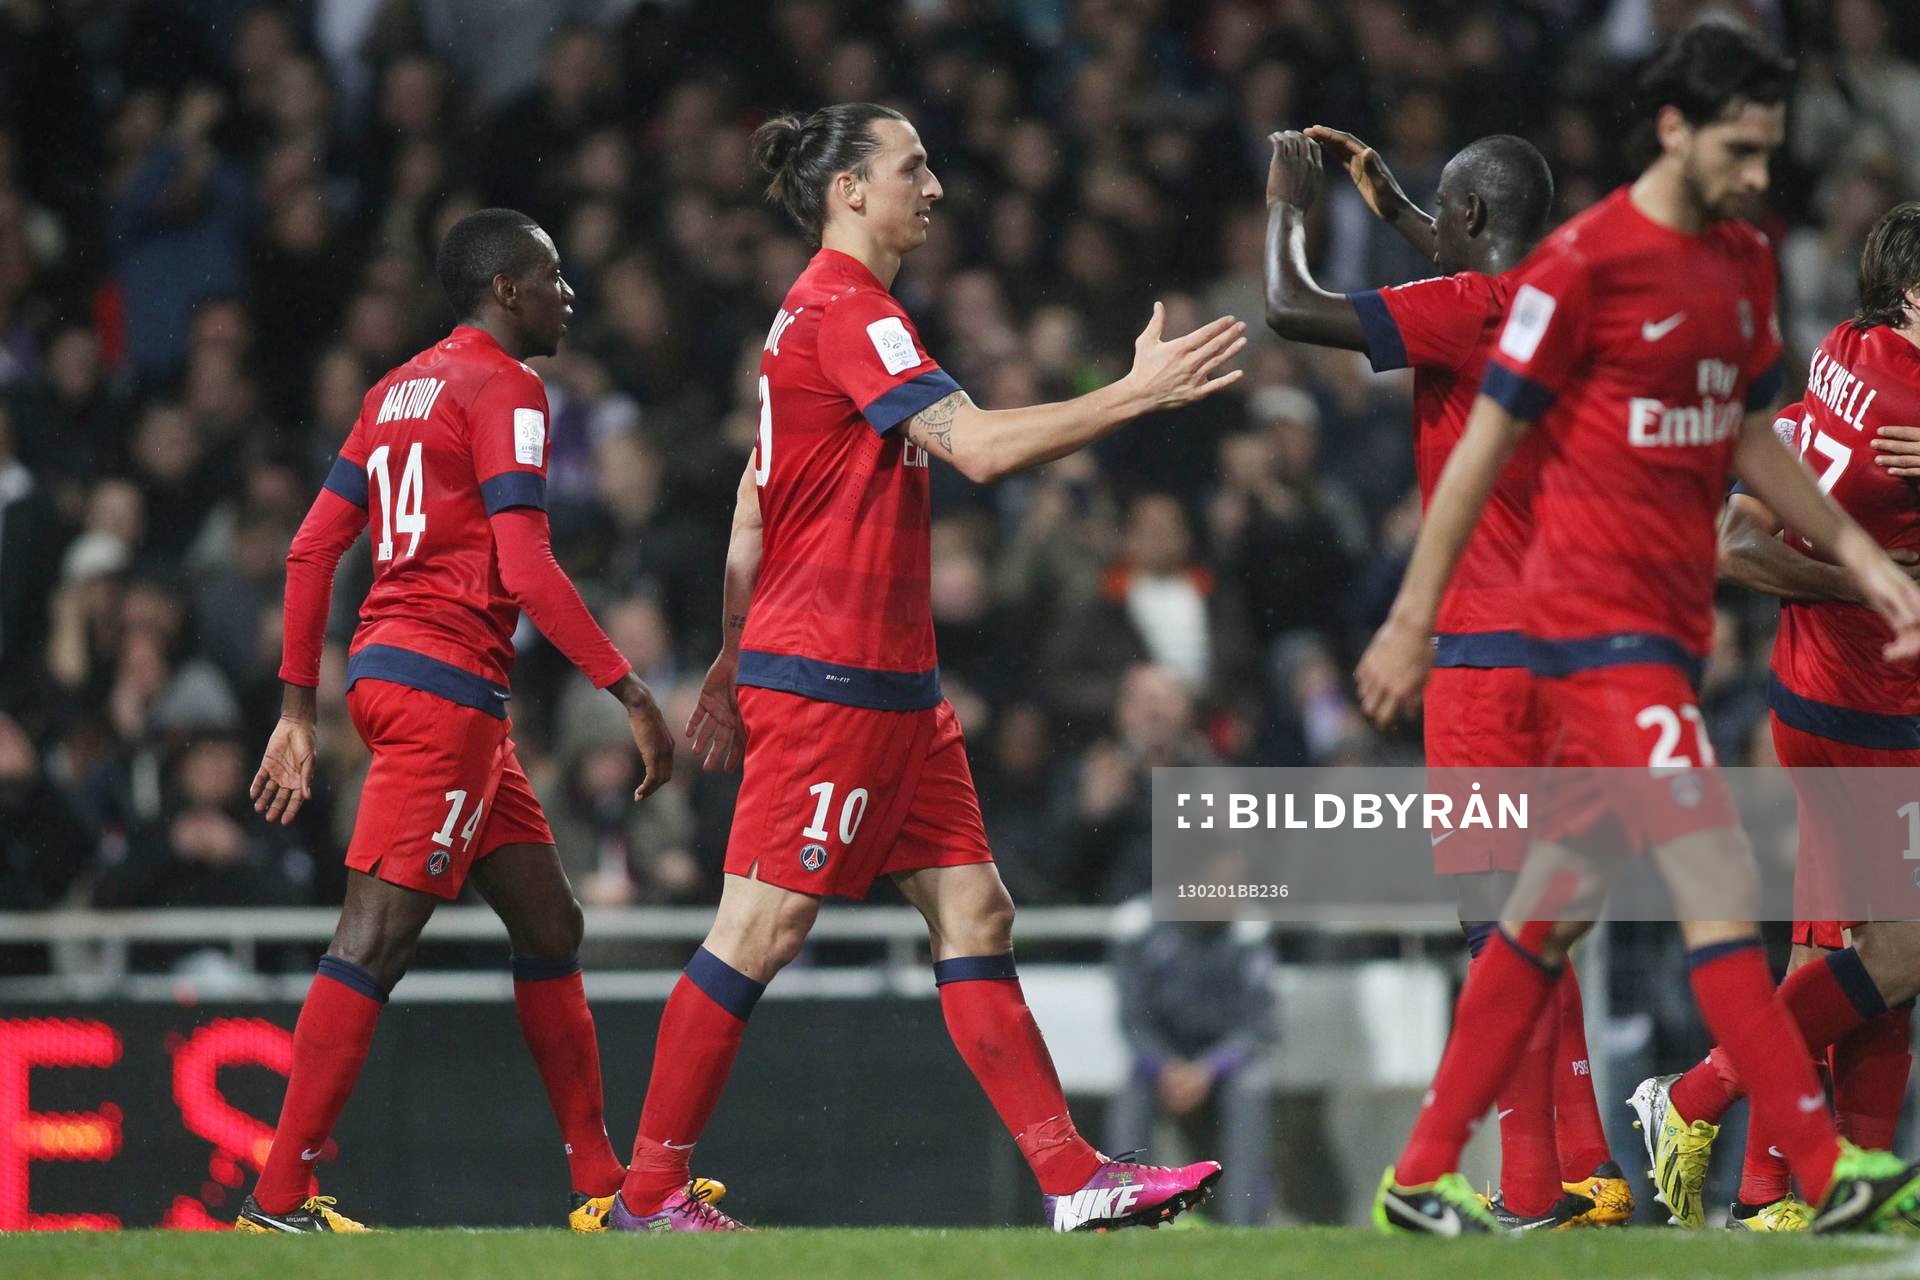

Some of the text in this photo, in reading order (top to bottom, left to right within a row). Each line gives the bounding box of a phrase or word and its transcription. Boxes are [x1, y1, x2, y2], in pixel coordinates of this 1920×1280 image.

[375, 377, 447, 425] MATUIDI
[366, 442, 426, 561] 14
[431, 789, 484, 853] 14
[802, 781, 868, 845] 10
[1053, 1184, 1145, 1233] NIKE
